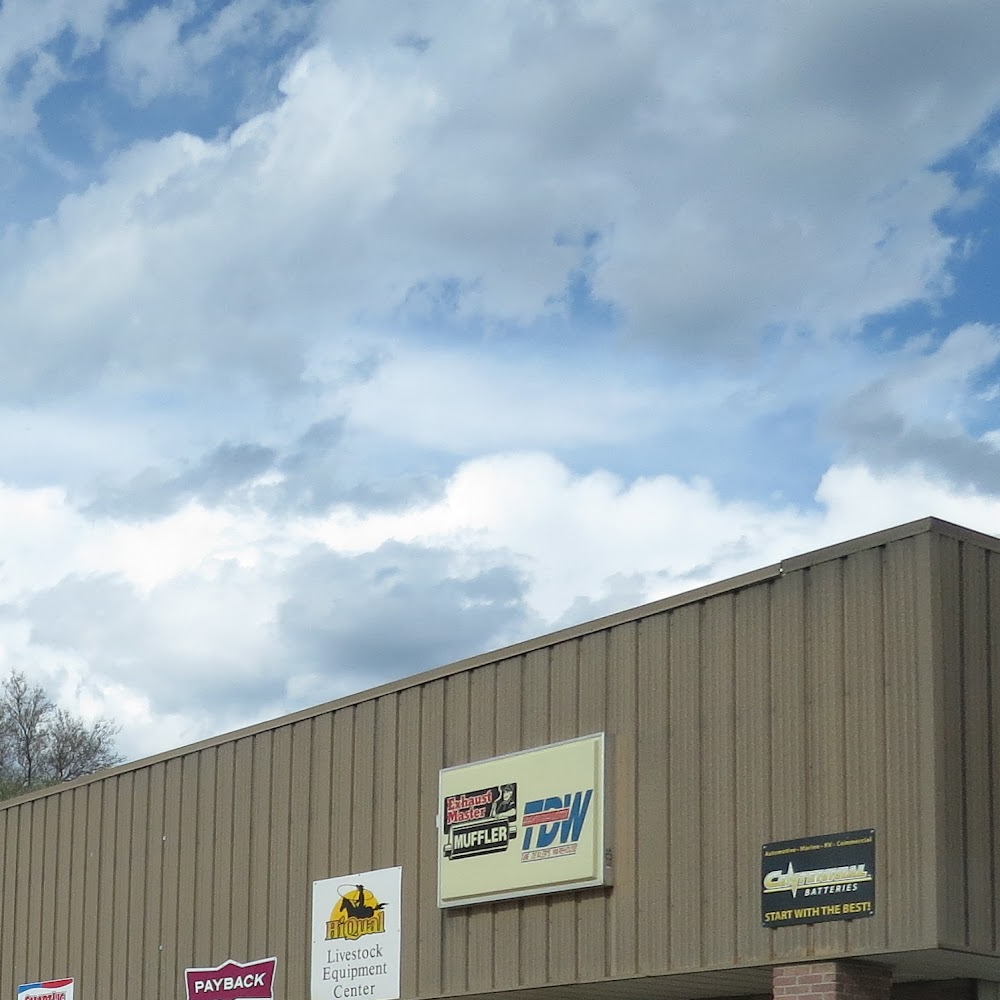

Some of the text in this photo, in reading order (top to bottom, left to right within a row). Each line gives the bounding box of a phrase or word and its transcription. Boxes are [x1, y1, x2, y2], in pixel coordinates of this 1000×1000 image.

[447, 789, 493, 811] Exhaust
[447, 807, 487, 824] Master
[521, 789, 594, 851] TDW
[454, 825, 508, 850] MUFFLER
[836, 837, 873, 847] Commercial
[804, 883, 858, 897] BATTERIES
[764, 901, 872, 922] START WITH THE BEST!
[327, 944, 383, 964] Livestock
[322, 962, 387, 982] Equipment
[194, 972, 266, 994] PAYBACK
[333, 984, 376, 999] Center
